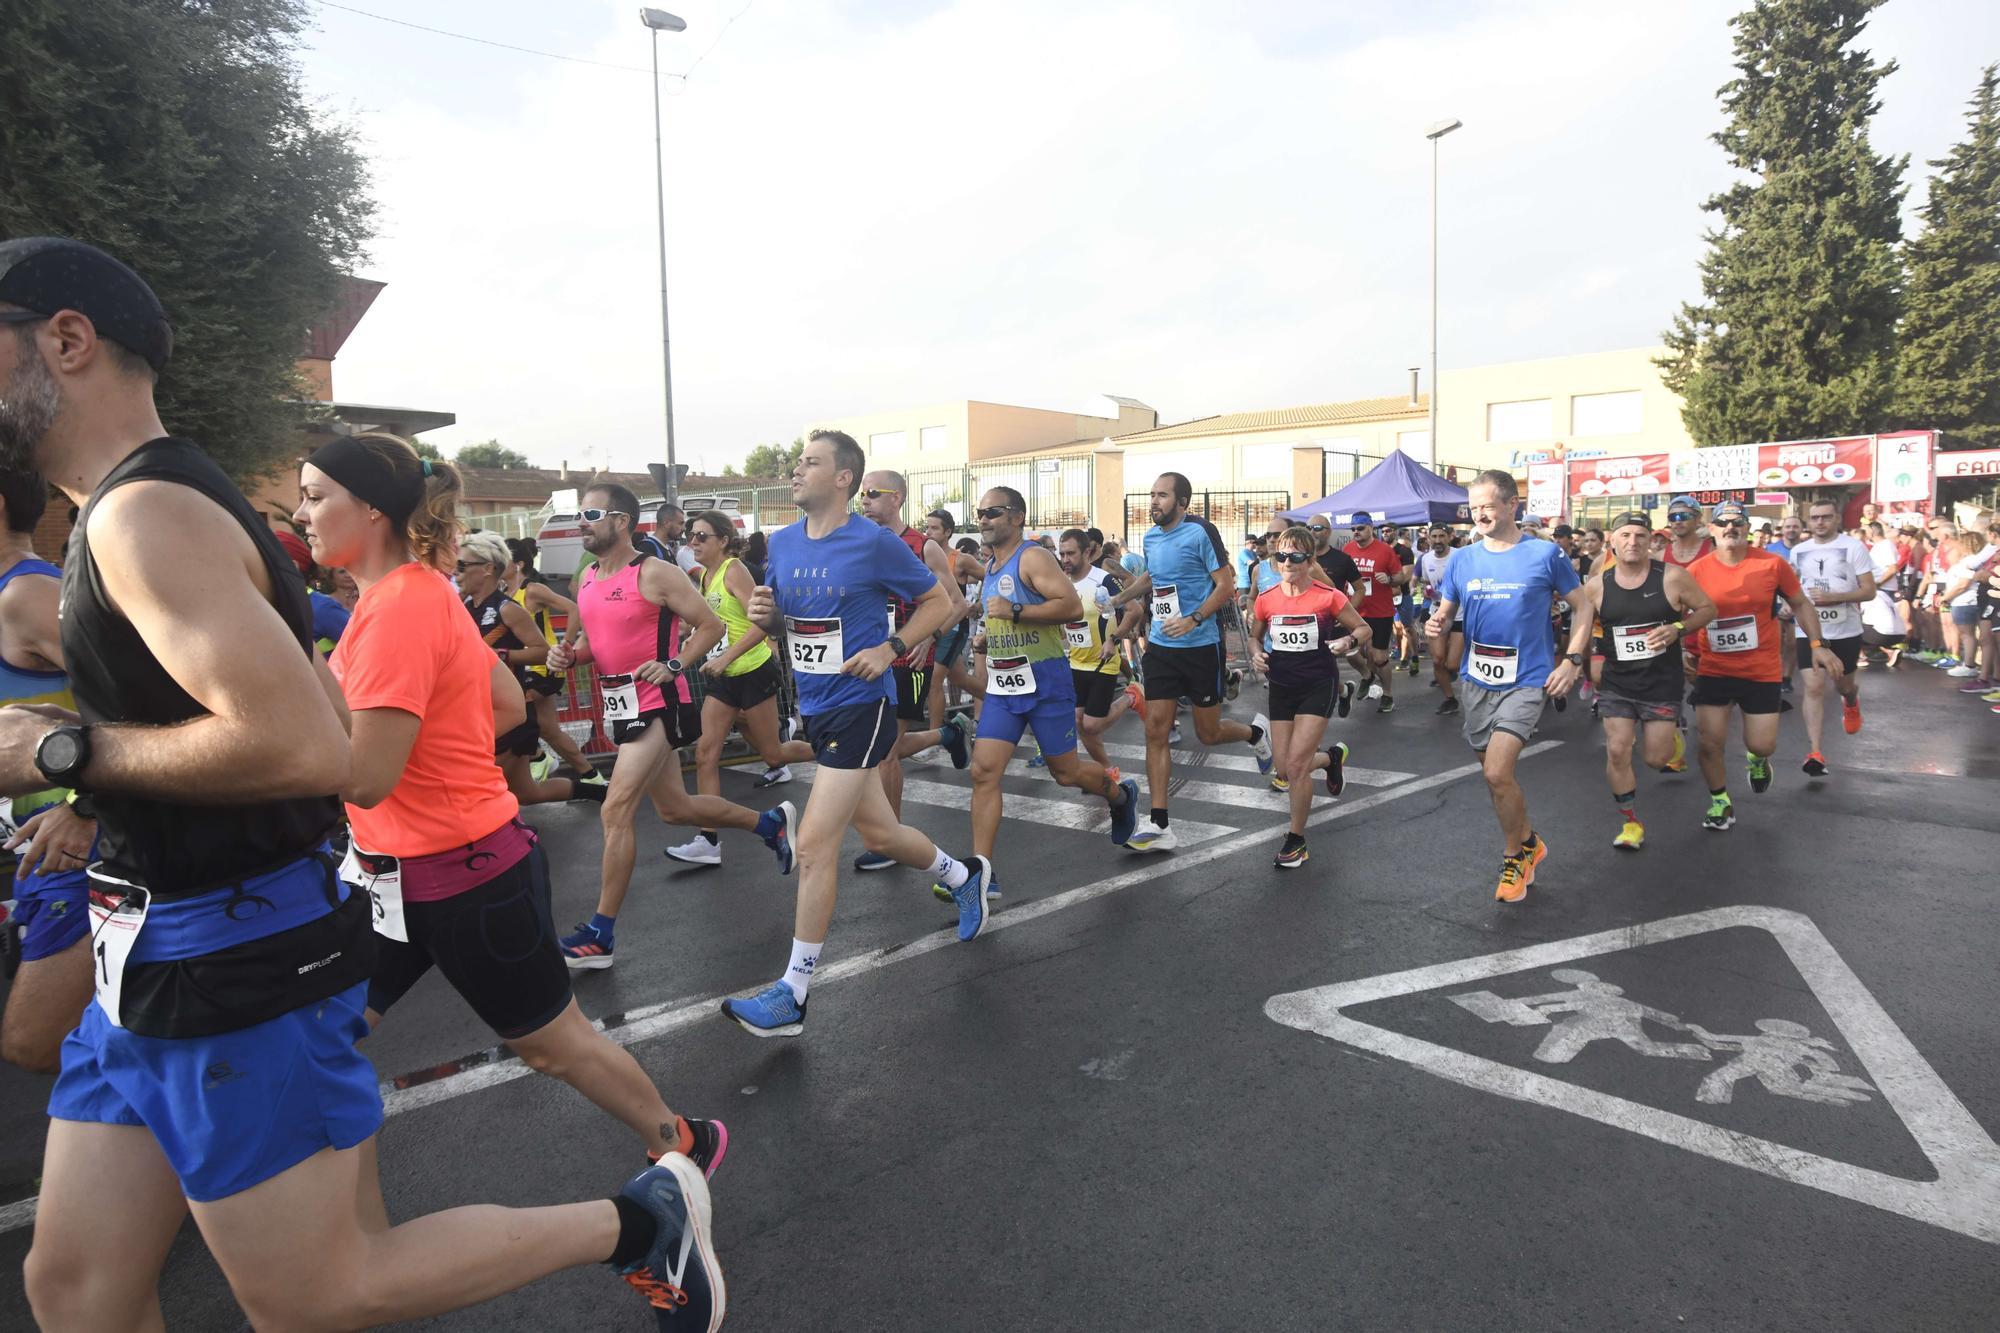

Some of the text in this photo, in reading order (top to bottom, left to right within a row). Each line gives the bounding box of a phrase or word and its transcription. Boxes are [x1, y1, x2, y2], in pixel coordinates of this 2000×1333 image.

[794, 567, 828, 578] NIKE
[1155, 602, 1171, 615] 088
[1000, 630, 1040, 649] BRUJAS
[1280, 632, 1309, 644] 303
[1717, 632, 1748, 646] 584
[794, 643, 828, 663] 527
[1625, 641, 1650, 653] 58
[996, 674, 1026, 688] 646
